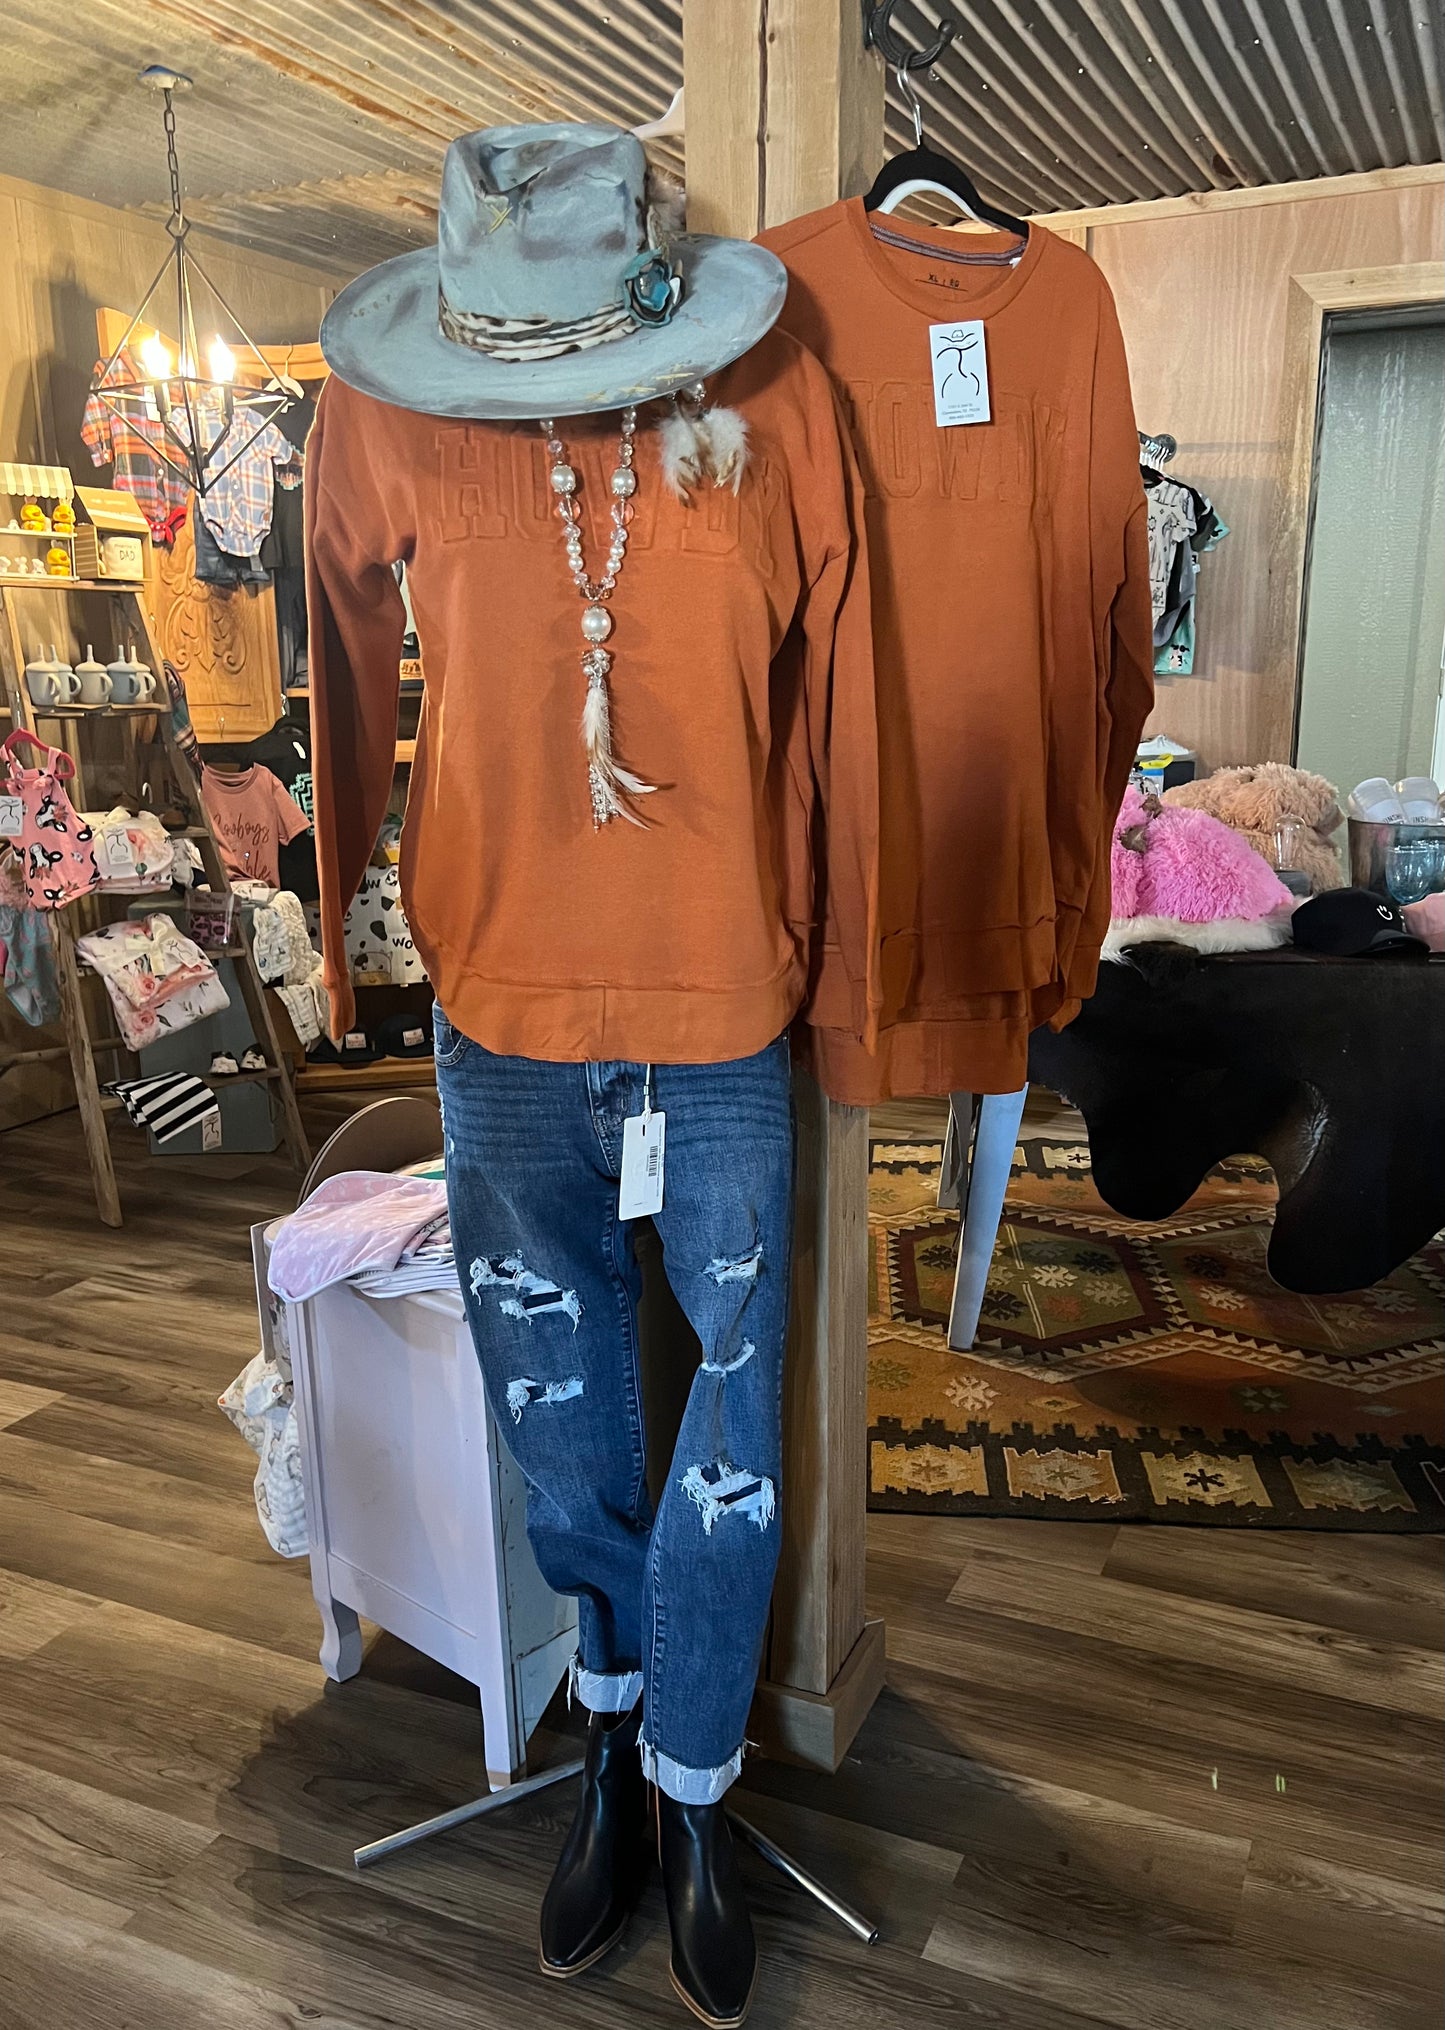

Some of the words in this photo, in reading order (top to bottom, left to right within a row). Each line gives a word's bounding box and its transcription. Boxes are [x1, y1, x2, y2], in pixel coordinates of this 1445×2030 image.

[928, 273, 938, 283] XL
[119, 549, 135, 561] DAD
[392, 937, 413, 950] WO
